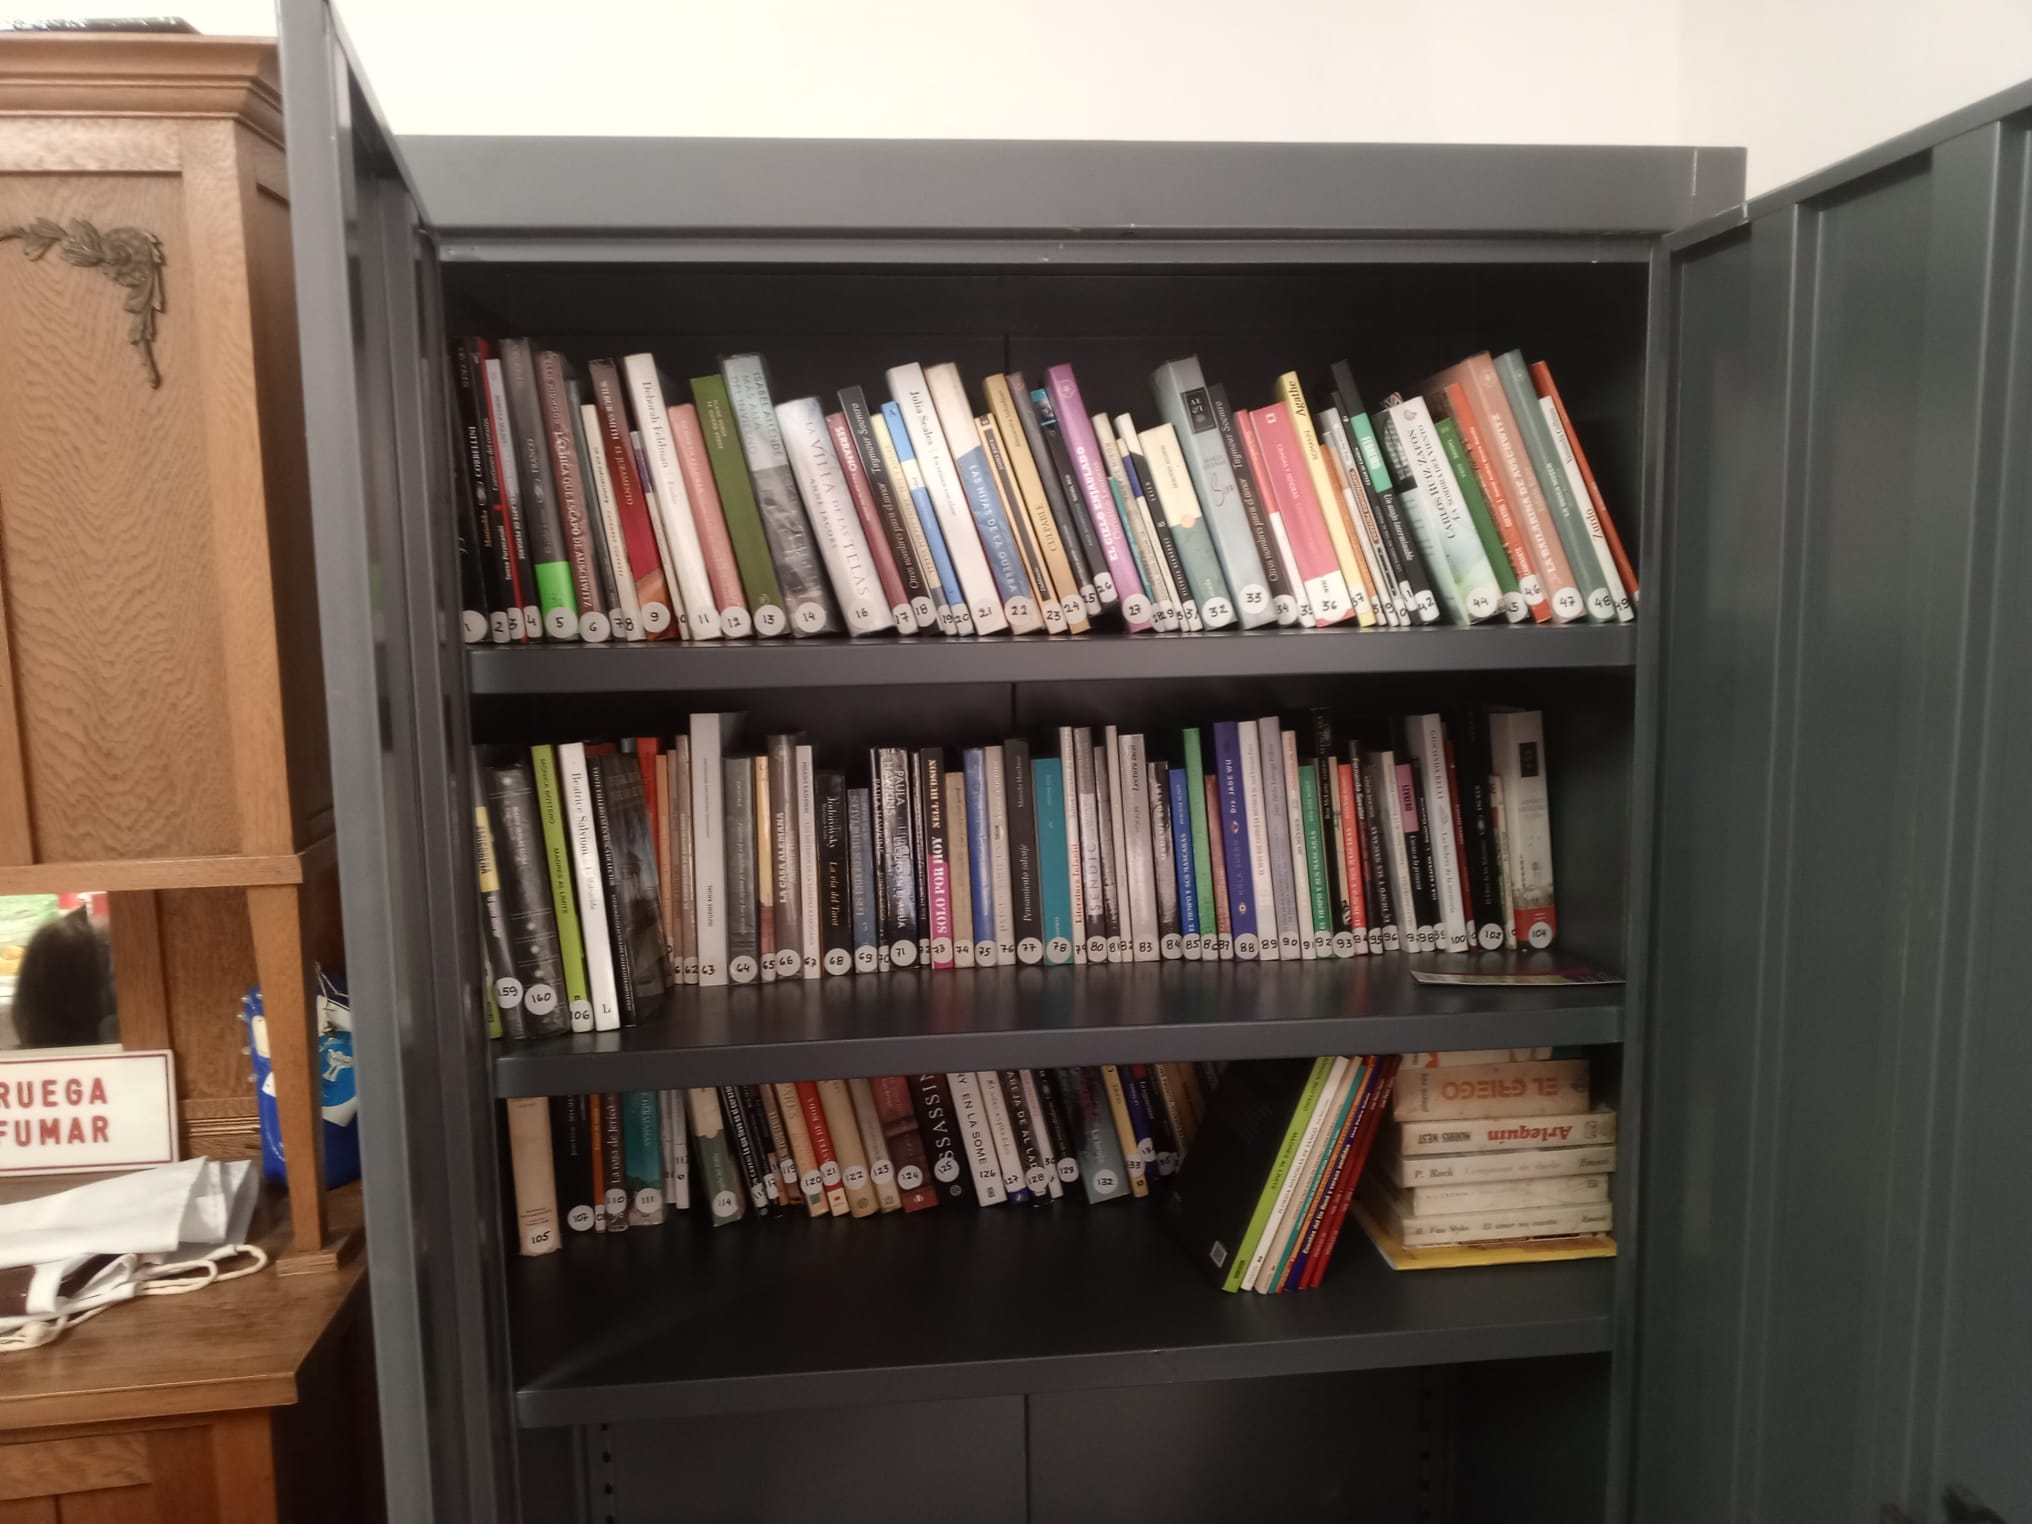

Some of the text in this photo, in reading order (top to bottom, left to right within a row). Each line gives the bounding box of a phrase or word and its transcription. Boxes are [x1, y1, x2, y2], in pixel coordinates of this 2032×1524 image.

[1285, 379, 1307, 418] Agathe
[641, 381, 671, 468] Deborah Feldman
[834, 424, 858, 472] SERRANO
[1420, 466, 1439, 496] RUIZ
[886, 509, 903, 533] para
[1432, 495, 1456, 539] CARLOS
[1093, 510, 1114, 545] CIELO
[1583, 507, 1604, 540] Zurdo
[893, 532, 913, 566] nombres
[840, 538, 870, 596] TELAS
[904, 566, 920, 590] Otros
[1525, 582, 1540, 596] 46
[1245, 592, 1264, 604] 33
[1471, 596, 1488, 609] 44
[1558, 596, 1575, 609] 47
[1594, 594, 1612, 608] 48
[855, 606, 869, 619] 16
[915, 602, 928, 616] 18
[978, 607, 993, 618] 21
[1011, 604, 1028, 616] 22
[1064, 602, 1081, 614] 24
[1128, 603, 1142, 616] 27
[1210, 605, 1229, 619] 32
[1322, 601, 1338, 613] 36
[527, 615, 537, 627] 4
[650, 611, 659, 623] 9
[699, 615, 709, 624] 11
[762, 614, 775, 626] 13
[802, 612, 816, 623] 14
[895, 611, 911, 625] 17
[1046, 609, 1062, 622] 23
[495, 621, 504, 632] 2
[556, 616, 564, 628] 5
[589, 621, 597, 632] 6
[625, 618, 634, 632] 8
[1224, 758, 1233, 773] WU
[894, 769, 905, 806] PAULA
[1225, 774, 1235, 795] JADE
[1350, 757, 1366, 820] Fernando Savater
[569, 772, 587, 813] Beatrice
[927, 758, 940, 828] NELL HUDSON
[774, 811, 787, 861] ALEMANA
[828, 861, 838, 872] La
[777, 862, 788, 888] CASA
[931, 835, 947, 933] SOLO POR HOY
[829, 890, 840, 902] del
[1369, 933, 1382, 945] 95
[1383, 932, 1399, 943] 96
[1450, 933, 1467, 944] 100
[1484, 929, 1502, 941] 102
[1531, 928, 1549, 939] 104
[1000, 943, 1015, 954] 76
[1022, 943, 1036, 954] 77
[1053, 941, 1067, 951] 78
[1090, 944, 1105, 953] 80
[1138, 943, 1153, 953] 83
[1185, 940, 1200, 950] 85
[1240, 943, 1256, 954] 88
[1261, 939, 1279, 950] 89
[1282, 938, 1299, 948] 90
[1315, 937, 1332, 948] 92
[1336, 939, 1352, 949] 93
[858, 953, 873, 964] 69
[896, 948, 906, 957] 71
[979, 947, 991, 958] 75
[762, 960, 775, 970] 65
[779, 958, 794, 968] 66
[830, 956, 844, 966] 68
[701, 964, 716, 976] 63
[736, 963, 750, 973] 64
[532, 991, 552, 1005] 160
[1441, 1077, 1560, 1101] EL GRIEGO
[606, 1135, 618, 1147] de
[609, 1150, 620, 1170] rosa
[845, 1170, 865, 1182] 122
[872, 1163, 890, 1177] 123
[979, 1169, 997, 1179] 126
[1060, 1165, 1076, 1175] 129
[609, 1171, 621, 1183] La
[805, 1176, 822, 1186] 120
[900, 1171, 920, 1182] 124
[1096, 1177, 1115, 1187] 132
[572, 1213, 589, 1223] 107
[531, 1230, 551, 1244] 105
